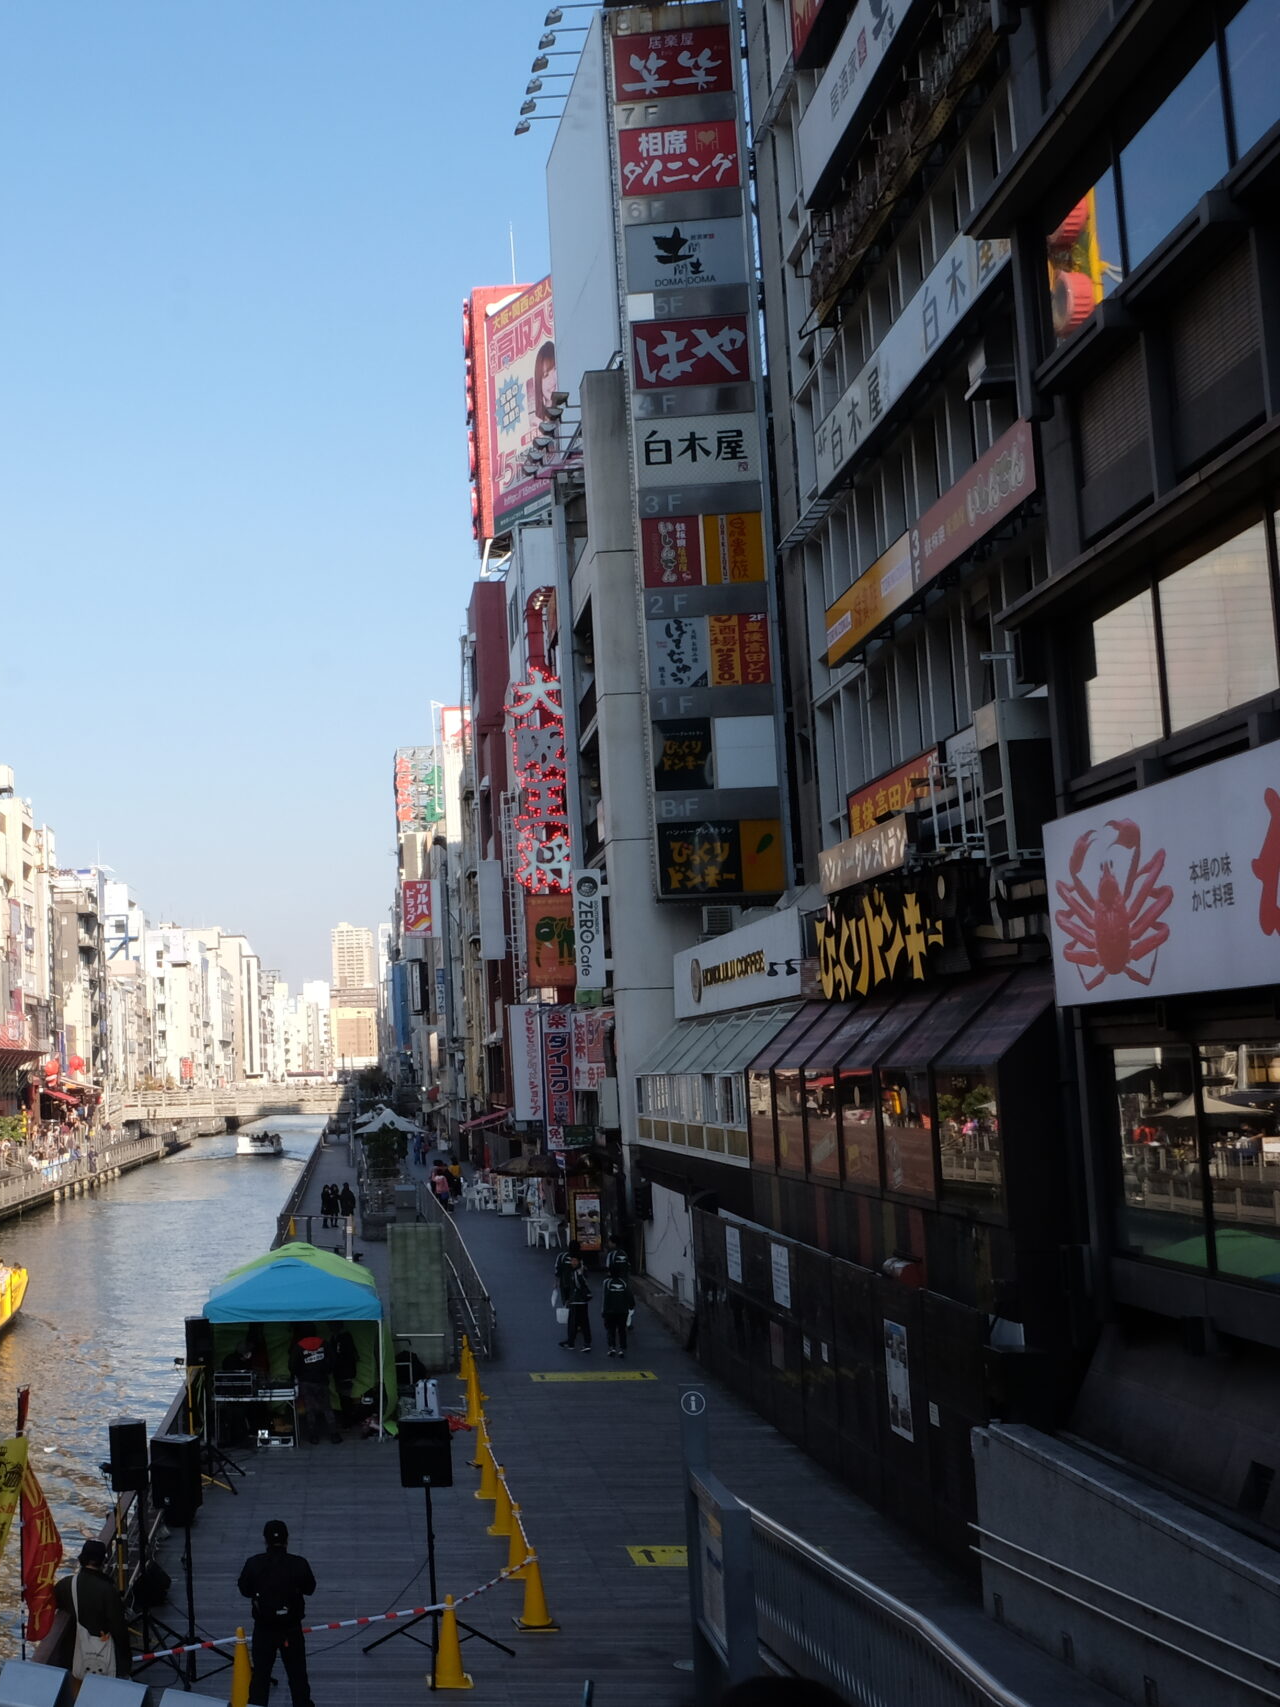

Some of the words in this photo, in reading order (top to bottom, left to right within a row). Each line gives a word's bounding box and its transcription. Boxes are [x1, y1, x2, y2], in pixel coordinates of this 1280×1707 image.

[622, 48, 722, 95] 笑笑
[621, 106, 658, 125] 7F
[639, 130, 687, 157] 相席
[623, 153, 736, 190] ダイニング
[830, 366, 883, 469] 白木屋
[644, 429, 748, 466] 白木屋
[645, 494, 682, 513] 3F
[650, 594, 688, 614] 2F
[749, 613, 766, 621] 2F
[658, 696, 692, 715] 1F
[504, 667, 572, 894] 大阪王将
[670, 841, 730, 864] びっくり
[667, 865, 736, 889] ドンキー
[1190, 853, 1232, 884] 本場の味
[406, 889, 416, 923] ドラッグ
[416, 883, 429, 915] ツルハ
[1192, 882, 1235, 912] かに料理
[578, 901, 595, 943] ZERO
[702, 960, 735, 987] HONOLULU
[736, 949, 766, 977] COFFEE
[549, 1033, 569, 1093] ダイコク
